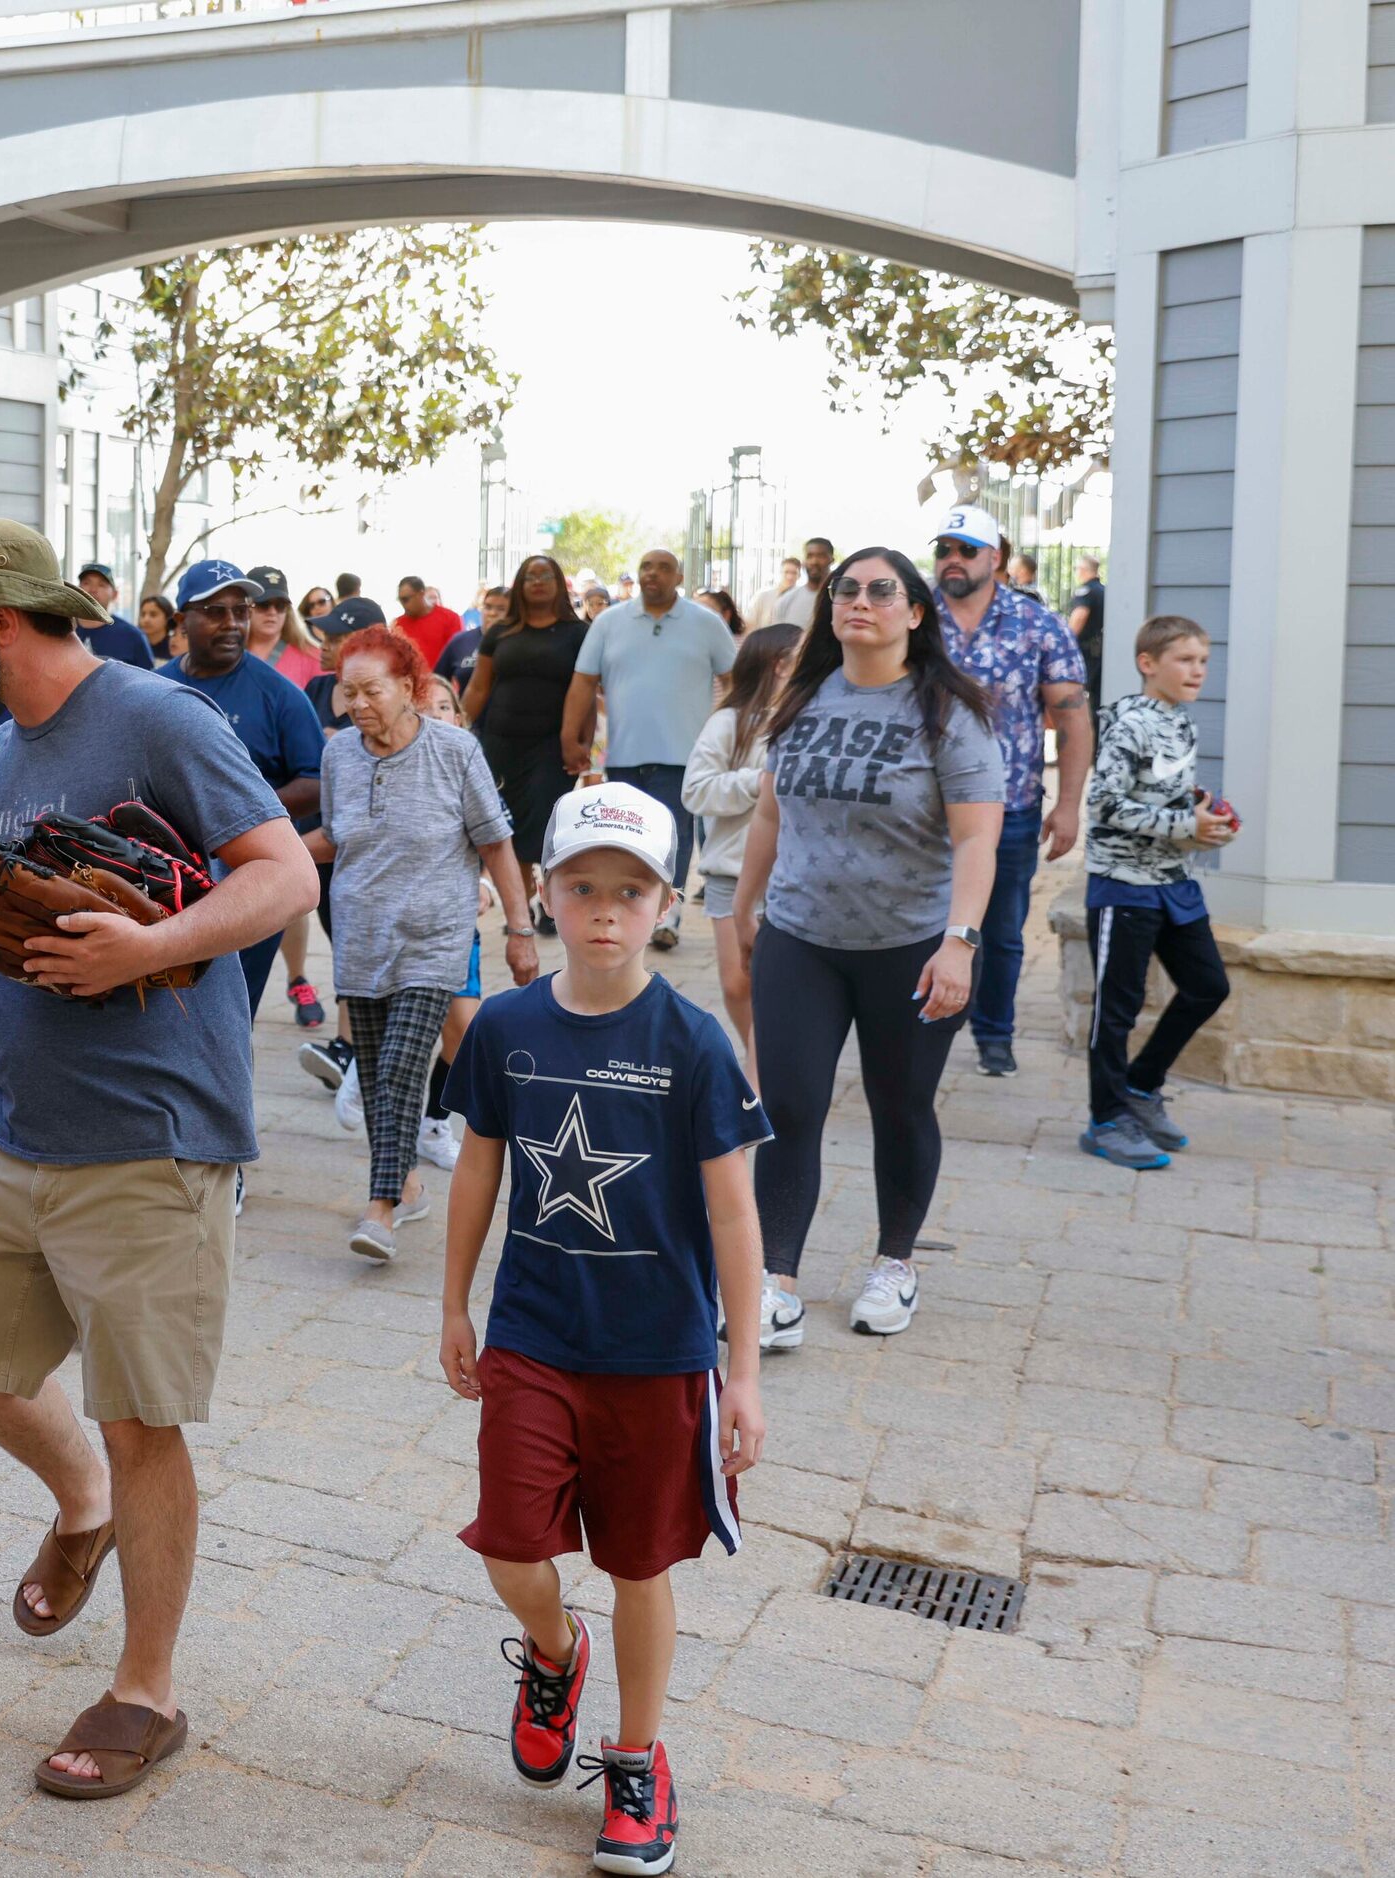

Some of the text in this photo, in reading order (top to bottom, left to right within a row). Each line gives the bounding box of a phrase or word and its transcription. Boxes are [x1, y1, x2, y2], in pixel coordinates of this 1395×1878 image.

[947, 513, 966, 530] B
[786, 716, 915, 764] BASE
[776, 754, 892, 805] BALL
[607, 1059, 673, 1076] DALLAS
[585, 1068, 671, 1088] COWBOYS
